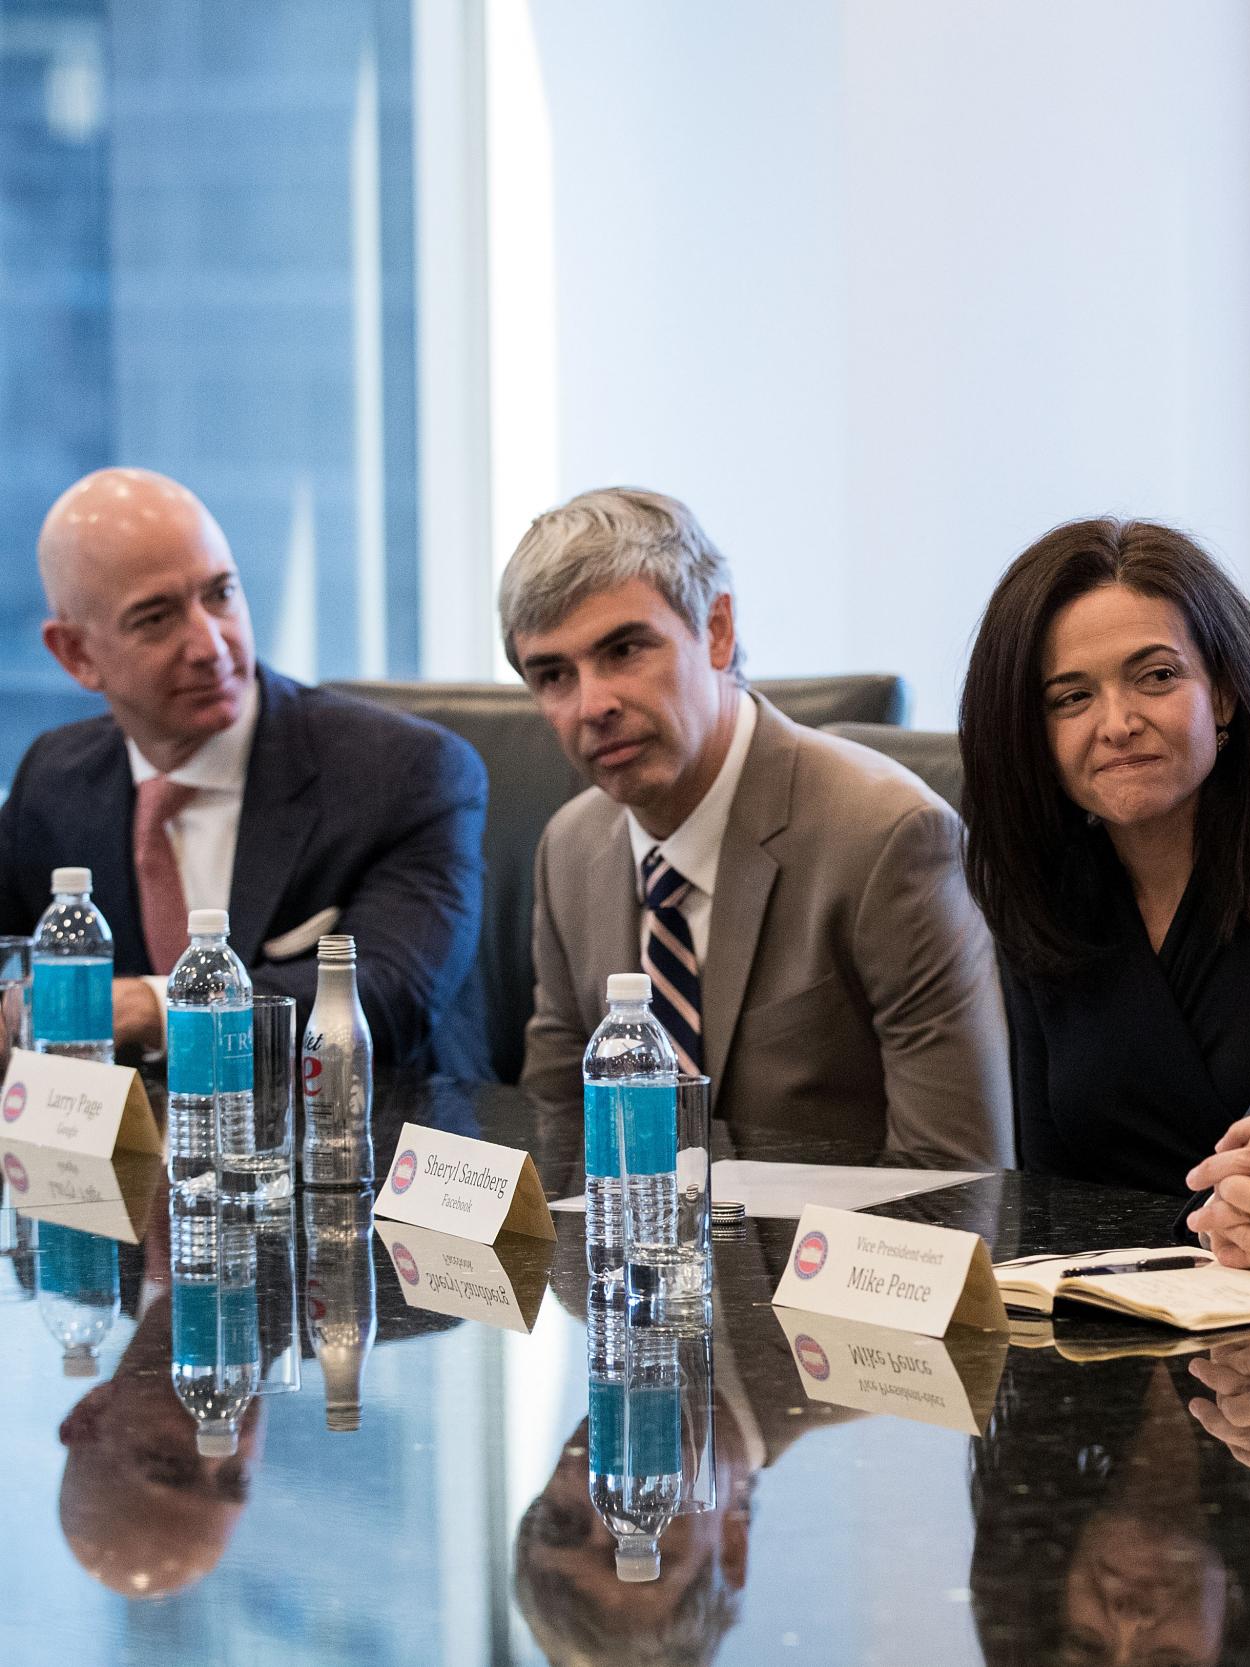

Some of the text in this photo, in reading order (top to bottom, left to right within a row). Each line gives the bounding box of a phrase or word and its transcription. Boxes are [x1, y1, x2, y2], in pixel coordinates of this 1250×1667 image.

[224, 1031, 252, 1052] TR
[304, 1030, 324, 1051] iet
[48, 1088, 104, 1122] Larry Page
[424, 1153, 461, 1185] Sheryl
[459, 1163, 509, 1200] Sandberg
[441, 1193, 473, 1213] Facebook
[857, 1235, 945, 1265] Vice President-elect
[846, 1265, 932, 1303] Mike Pence
